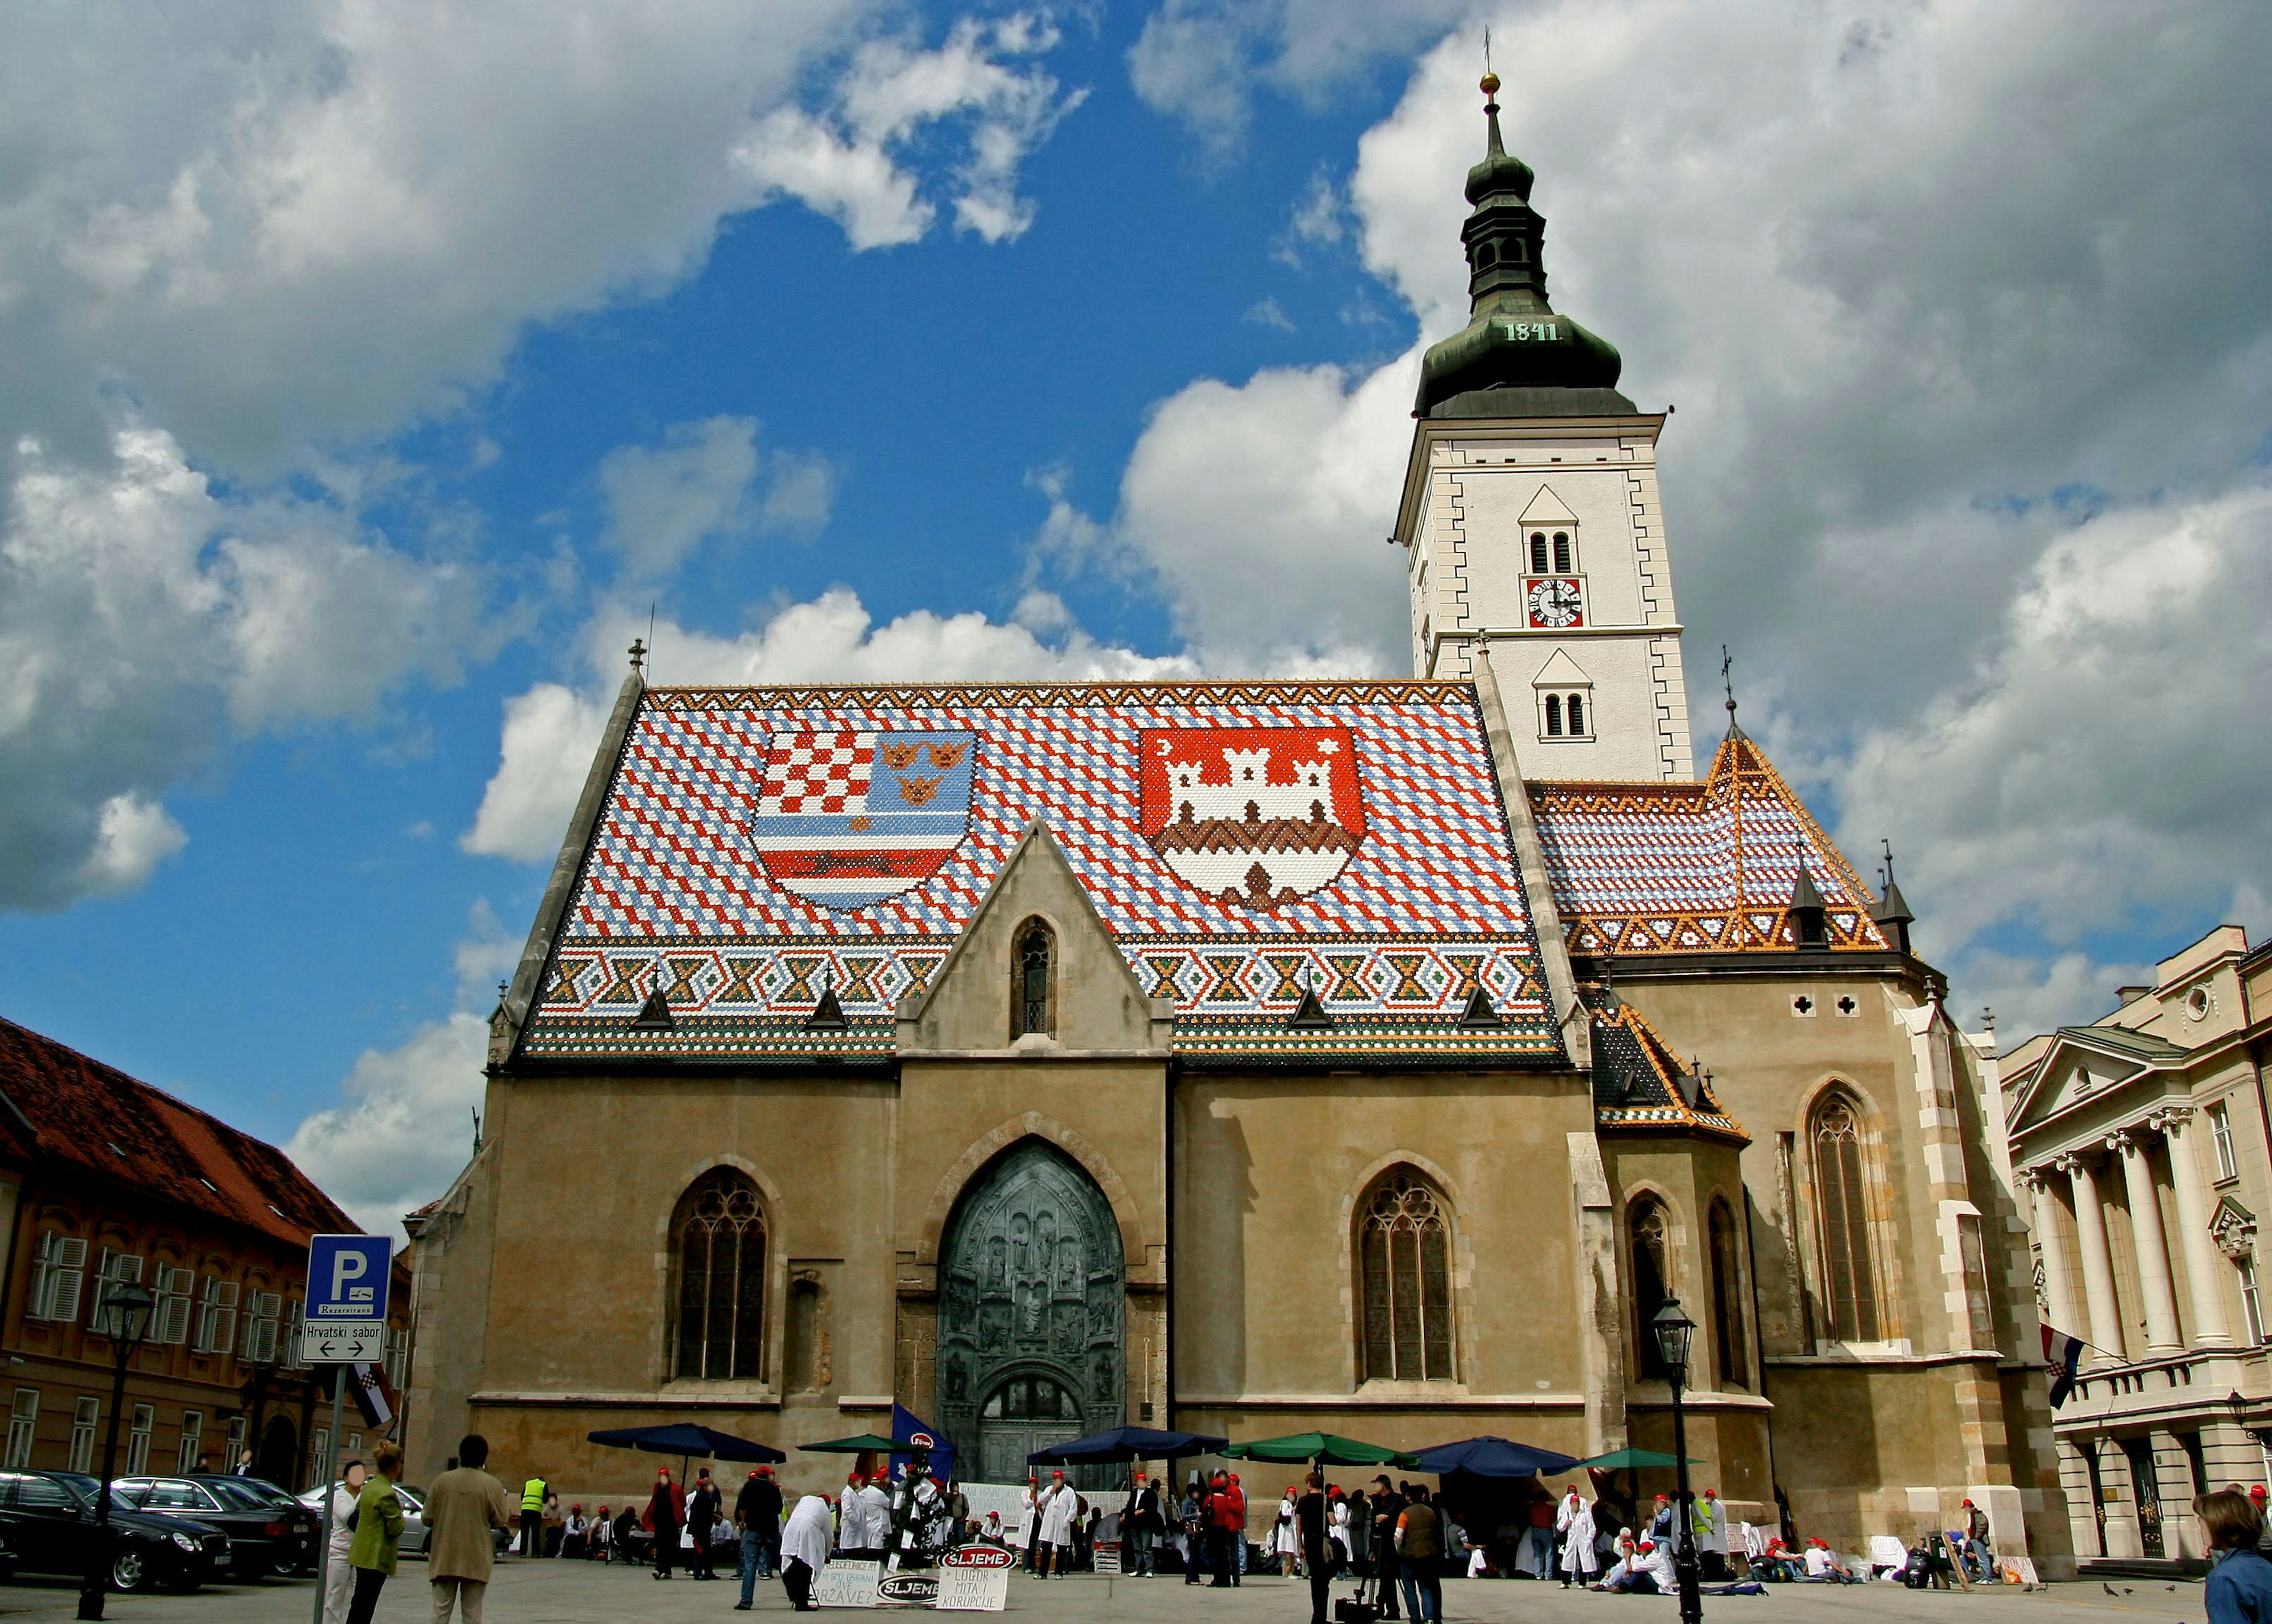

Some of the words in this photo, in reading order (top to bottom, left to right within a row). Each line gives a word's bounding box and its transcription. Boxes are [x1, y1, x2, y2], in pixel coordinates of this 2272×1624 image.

[331, 1250, 367, 1300] P
[307, 1326, 347, 1338] Hrvatski
[353, 1326, 380, 1338] sabor
[948, 1553, 1006, 1565] SLJEME
[954, 1570, 989, 1581] LOGOR
[884, 1583, 940, 1594] SLJEME
[954, 1583, 977, 1593] MITA
[982, 1584, 987, 1594] I
[943, 1596, 996, 1607] KORUPCIJE
